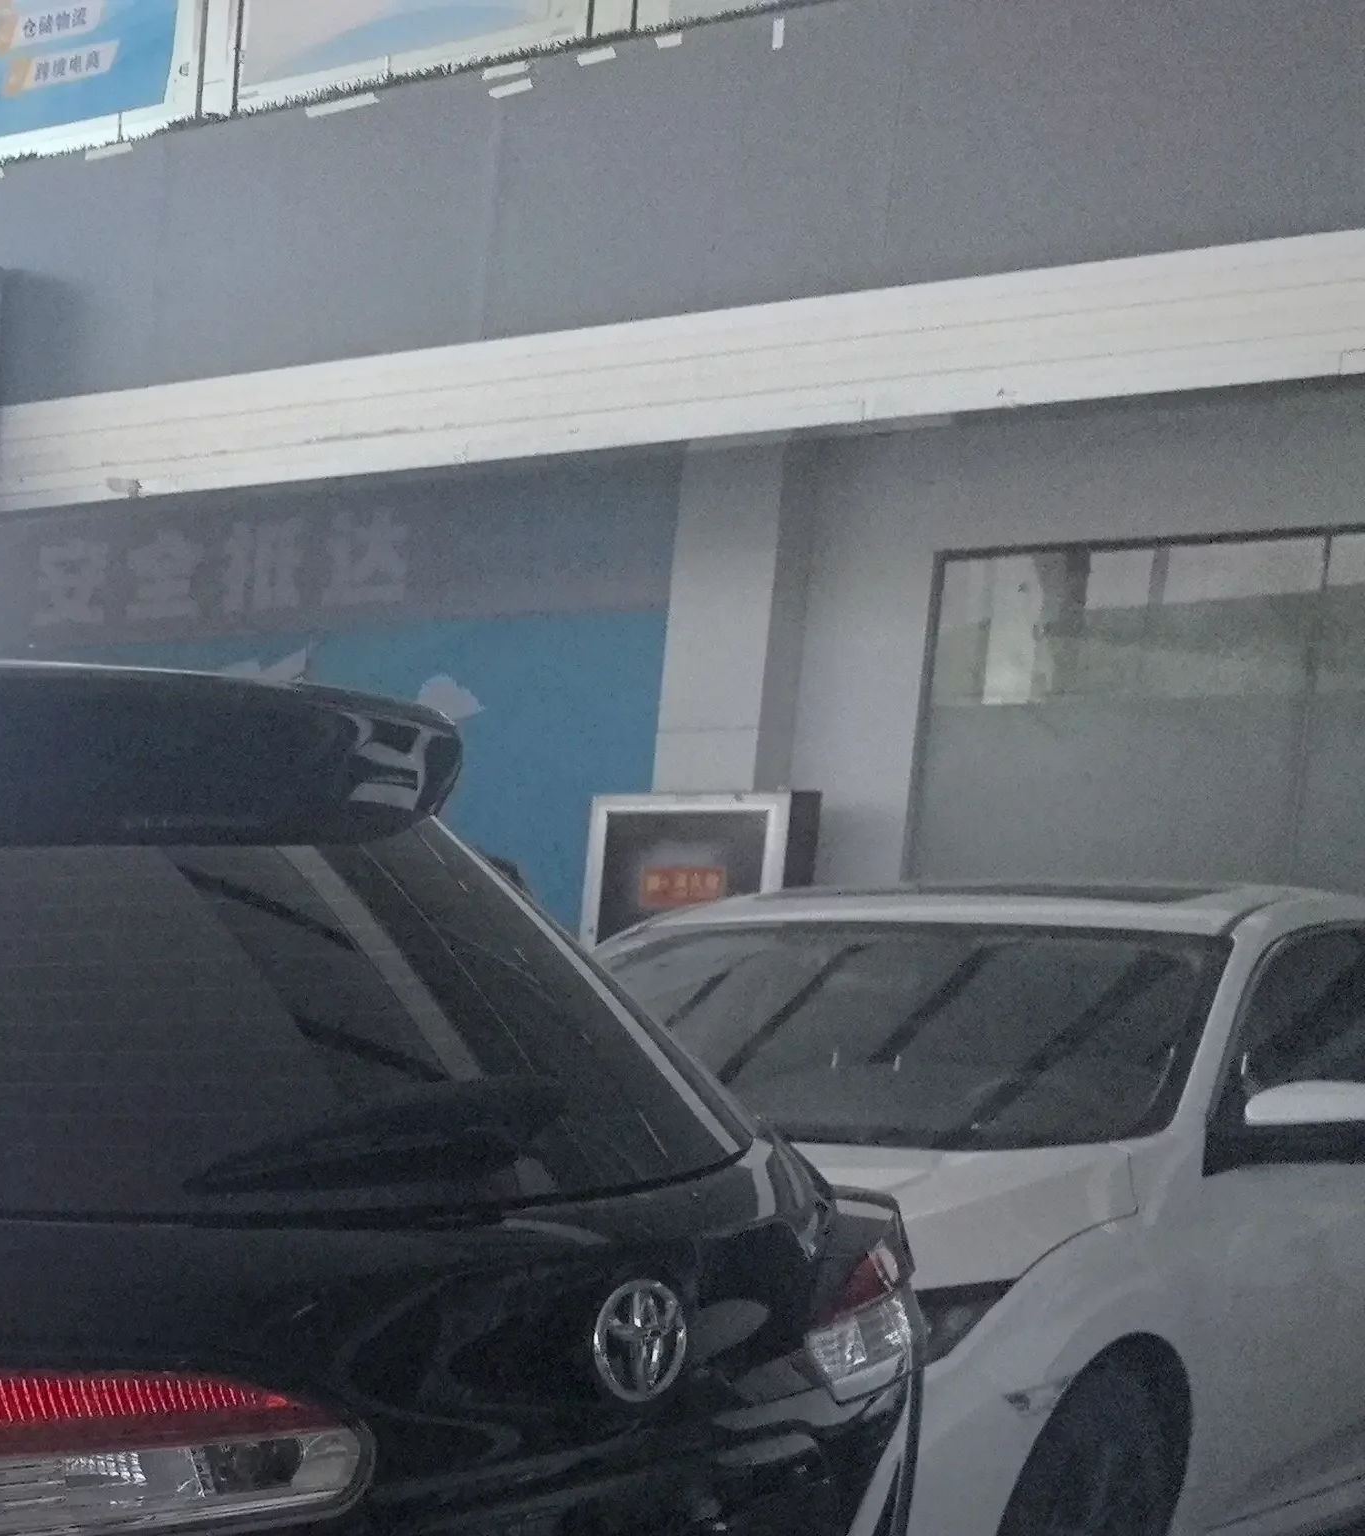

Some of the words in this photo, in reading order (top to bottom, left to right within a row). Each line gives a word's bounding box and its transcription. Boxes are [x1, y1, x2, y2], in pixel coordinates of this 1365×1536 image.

[23, 6, 87, 38] 仓储物流
[35, 49, 100, 83] 跨境电商
